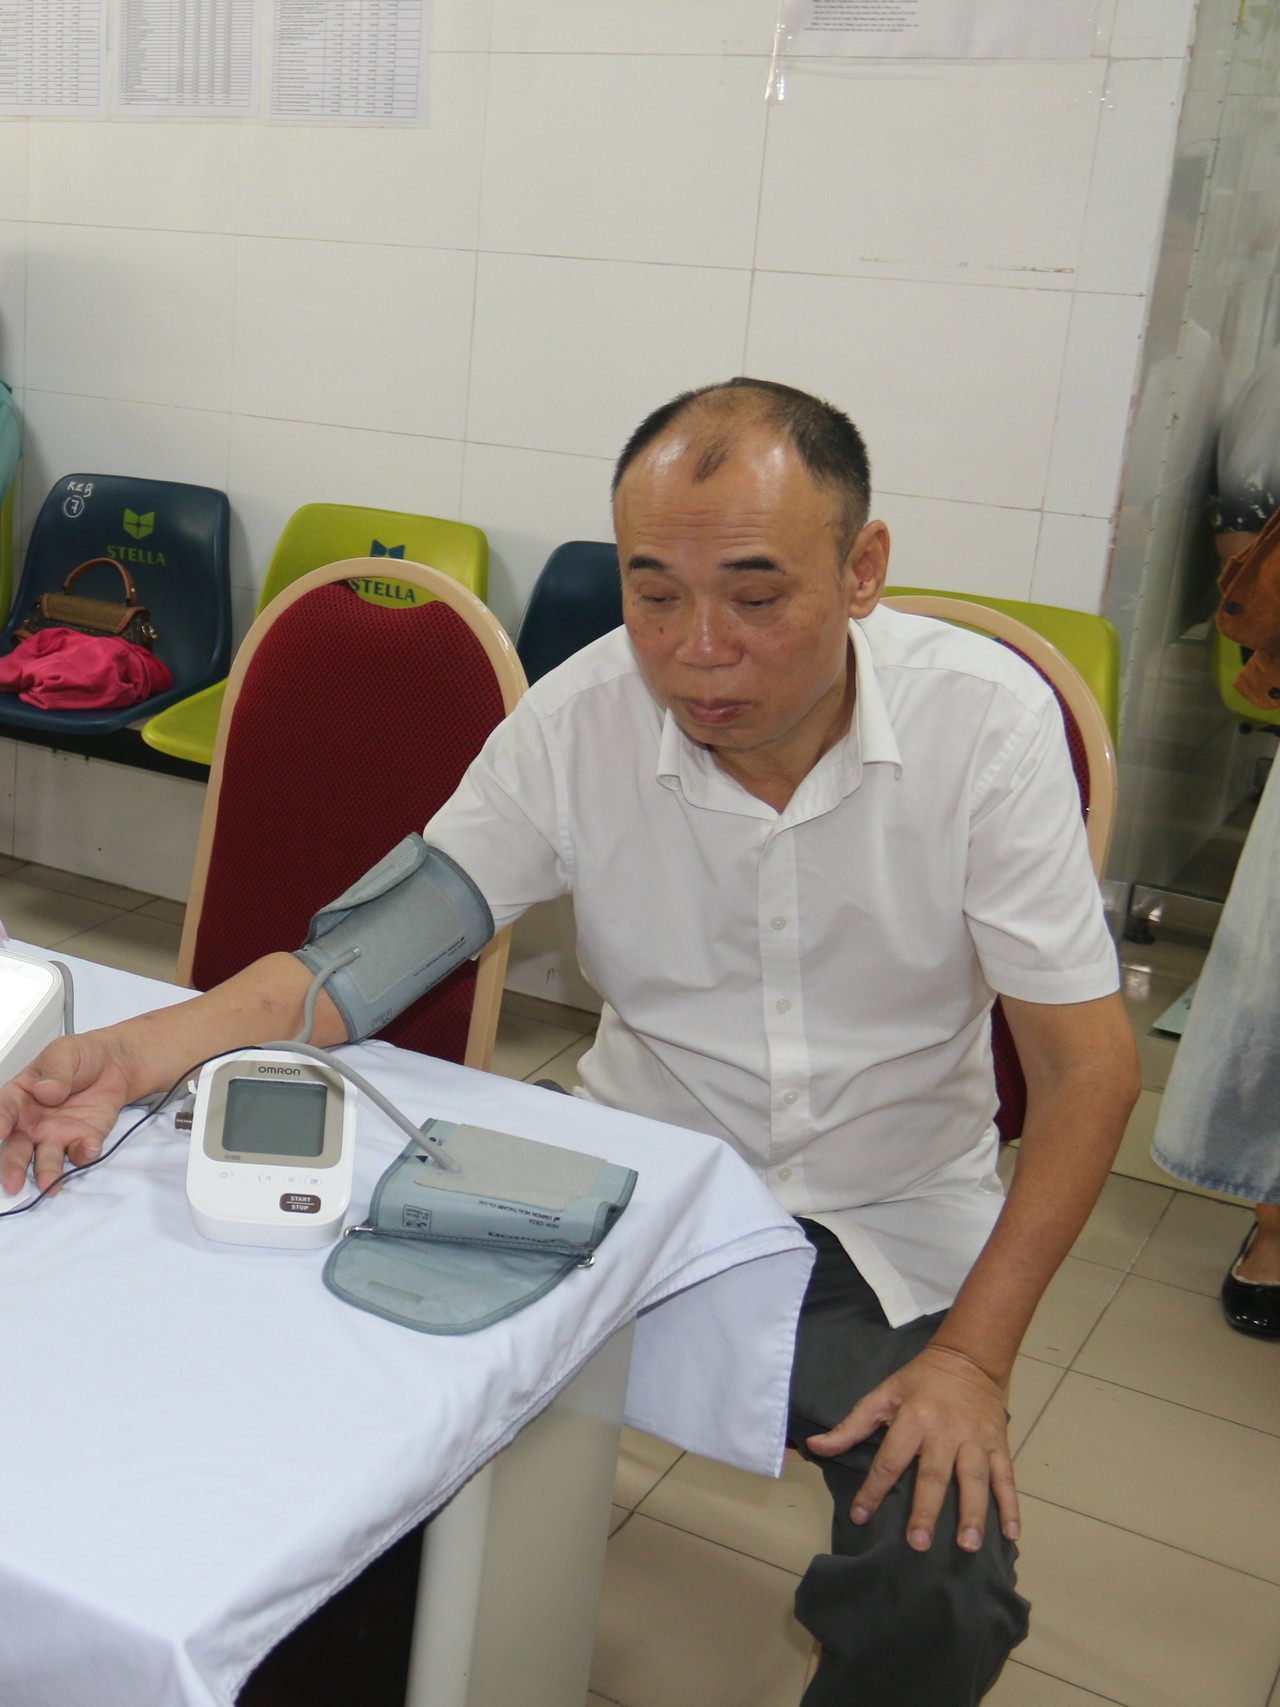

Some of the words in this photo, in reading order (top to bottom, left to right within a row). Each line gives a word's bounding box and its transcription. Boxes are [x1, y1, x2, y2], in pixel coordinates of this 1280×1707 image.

[106, 544, 166, 566] STELLA
[349, 578, 416, 604] STELLA
[257, 1065, 301, 1076] OMRON
[290, 1195, 311, 1203] START
